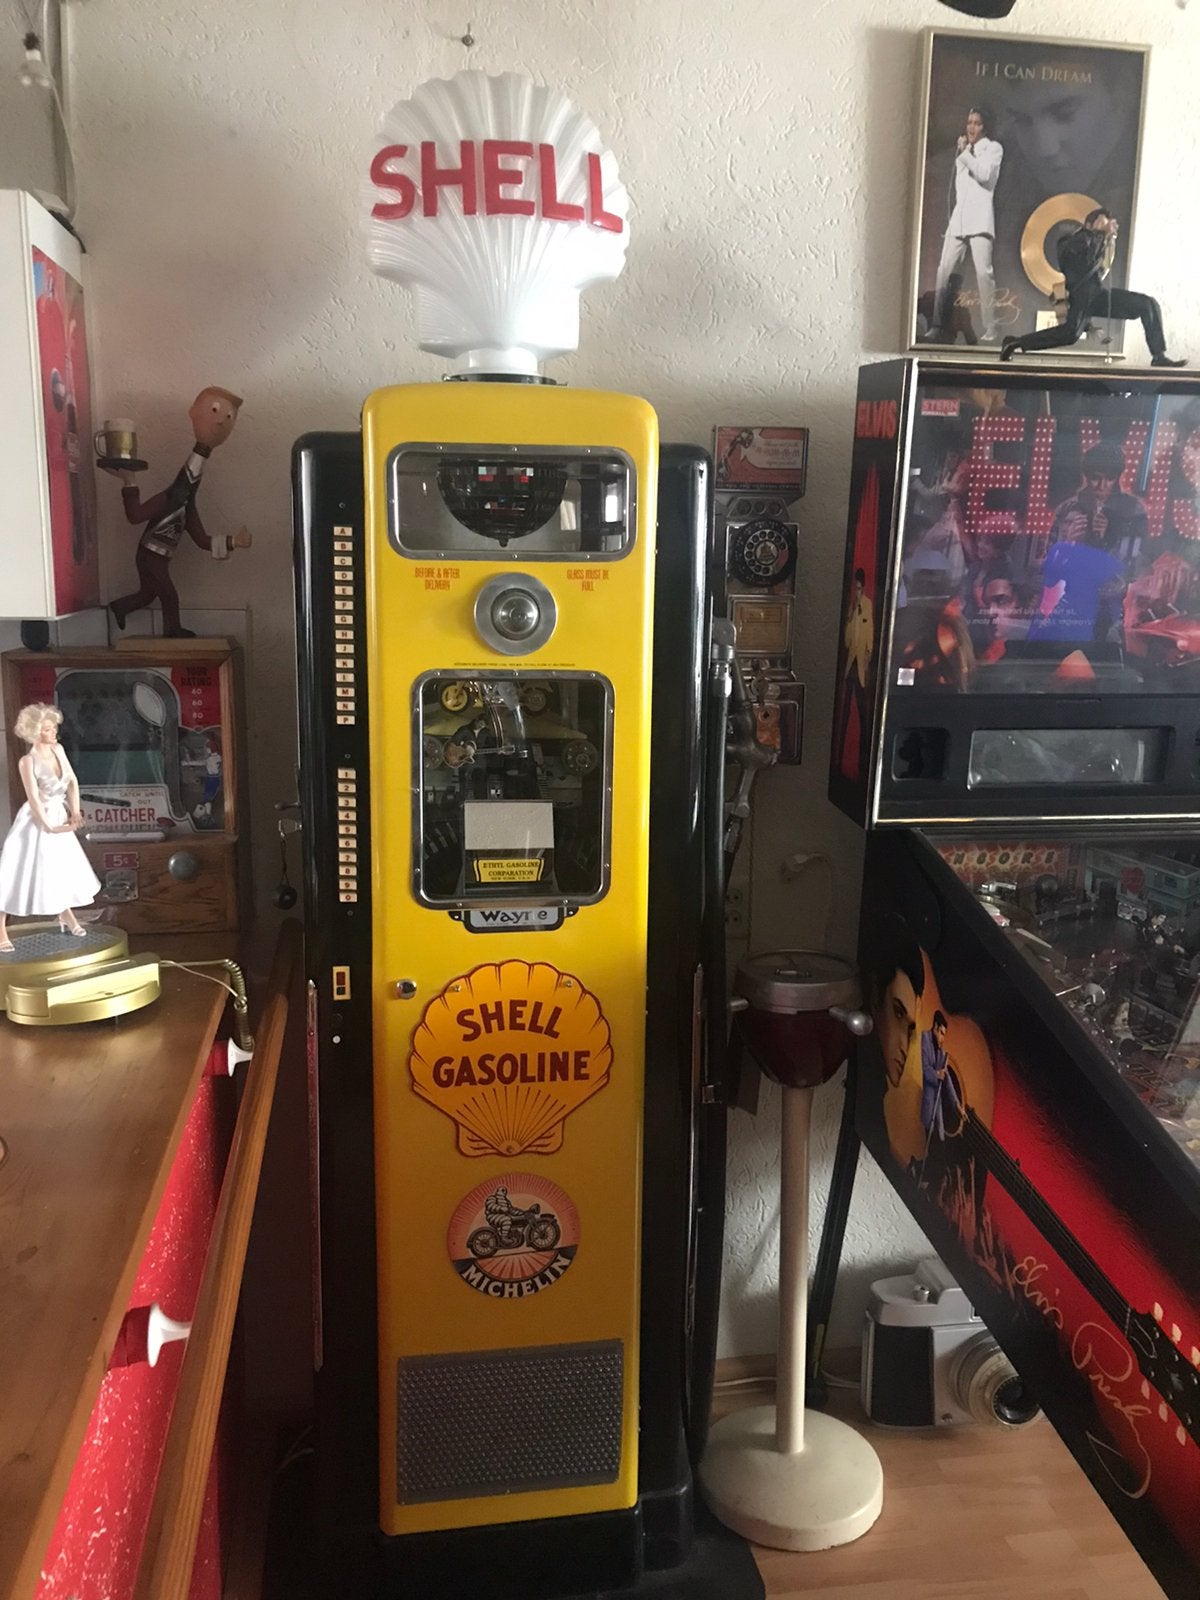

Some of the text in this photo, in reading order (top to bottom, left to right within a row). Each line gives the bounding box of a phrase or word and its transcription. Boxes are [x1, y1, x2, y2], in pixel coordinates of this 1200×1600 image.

[975, 61, 1092, 83] IF I CAN DREAM
[370, 139, 623, 234] SHELL
[857, 399, 897, 438] ELVIS
[921, 399, 959, 411] STERN
[95, 807, 156, 823] CATCHER
[488, 869, 534, 877] CORPARATION
[456, 999, 563, 1042] SHELL
[432, 1050, 591, 1089] GASOLINE
[461, 1254, 572, 1299] MICHELIN
[1013, 1256, 1064, 1330] Elvis
